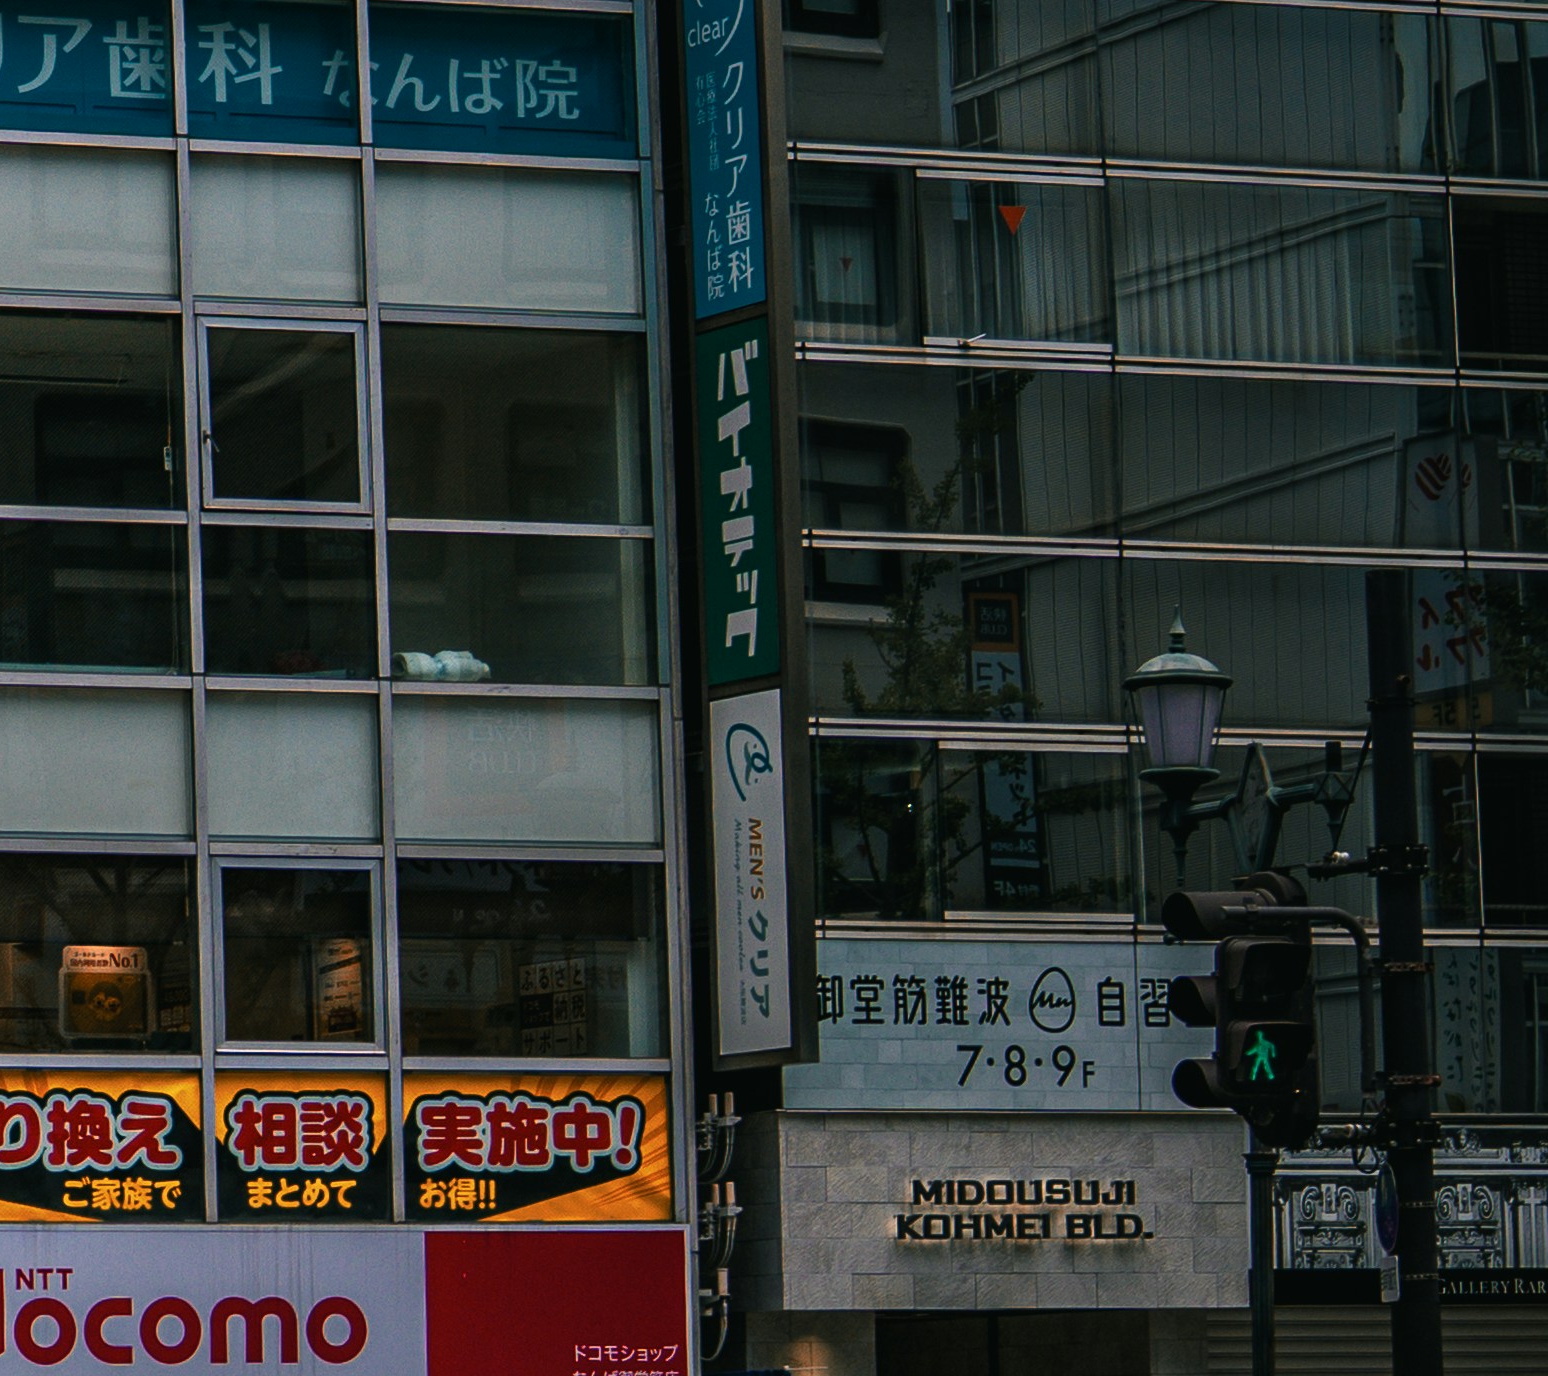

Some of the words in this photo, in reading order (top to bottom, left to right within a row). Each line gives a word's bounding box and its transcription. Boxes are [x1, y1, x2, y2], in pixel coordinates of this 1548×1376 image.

[687, 15, 728, 48] clear
[322, 46, 582, 123] なんば院
[722, 61, 755, 293] クリア歯科
[704, 192, 725, 301] なんば院
[717, 338, 758, 657] バイオテック
[747, 908, 771, 1020] クリア
[232, 1094, 374, 1176] 相談
[416, 1094, 642, 1176] 実施中!
[60, 1178, 182, 1210] ご家族で
[245, 1178, 358, 1210] まとめて
[418, 1178, 500, 1210] お得!!
[911, 1178, 1137, 1208] MIDOUSUJI
[894, 1212, 1051, 1241] KOHMEI
[1065, 1212, 1154, 1241] BLD.
[12, 1268, 73, 1290] NTT
[570, 1343, 680, 1364] ドコモショップ
